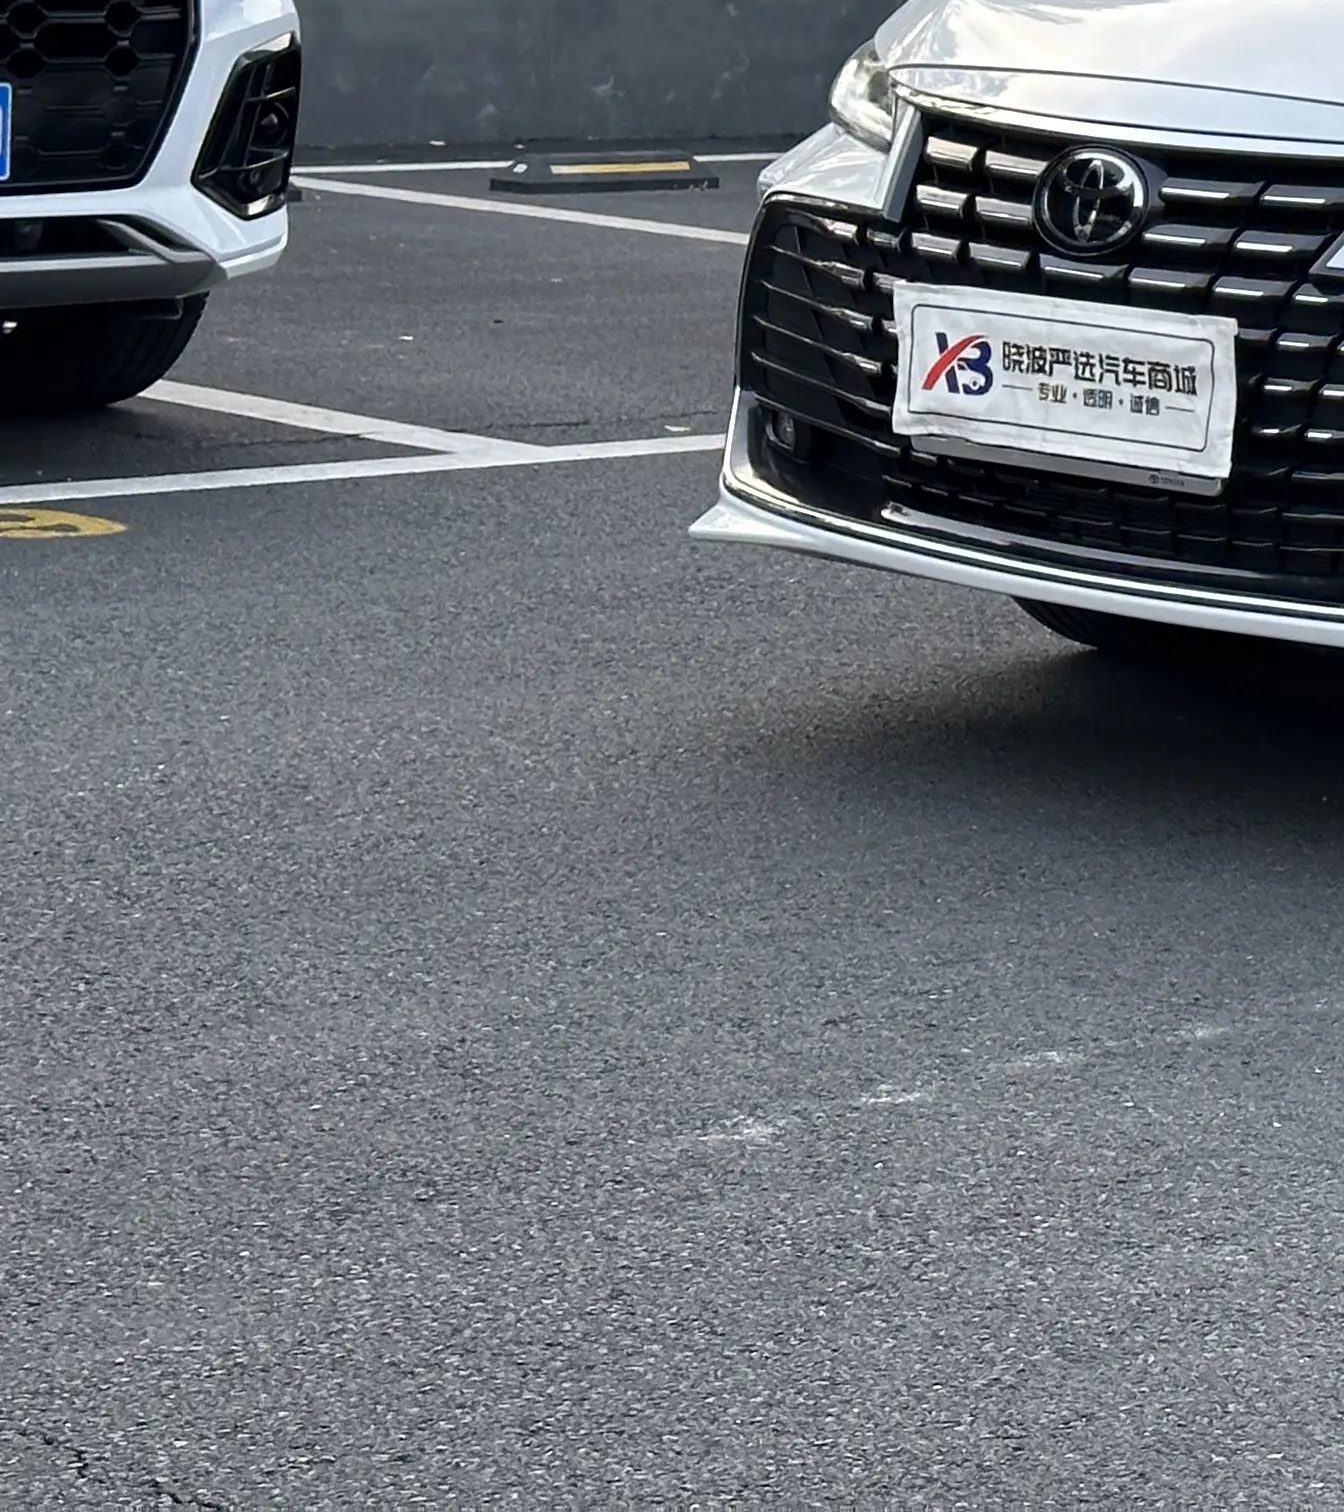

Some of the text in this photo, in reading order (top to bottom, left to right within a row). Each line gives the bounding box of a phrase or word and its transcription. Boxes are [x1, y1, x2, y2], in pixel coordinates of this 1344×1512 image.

[1002, 340, 1198, 397] 晓波严选汽车商城
